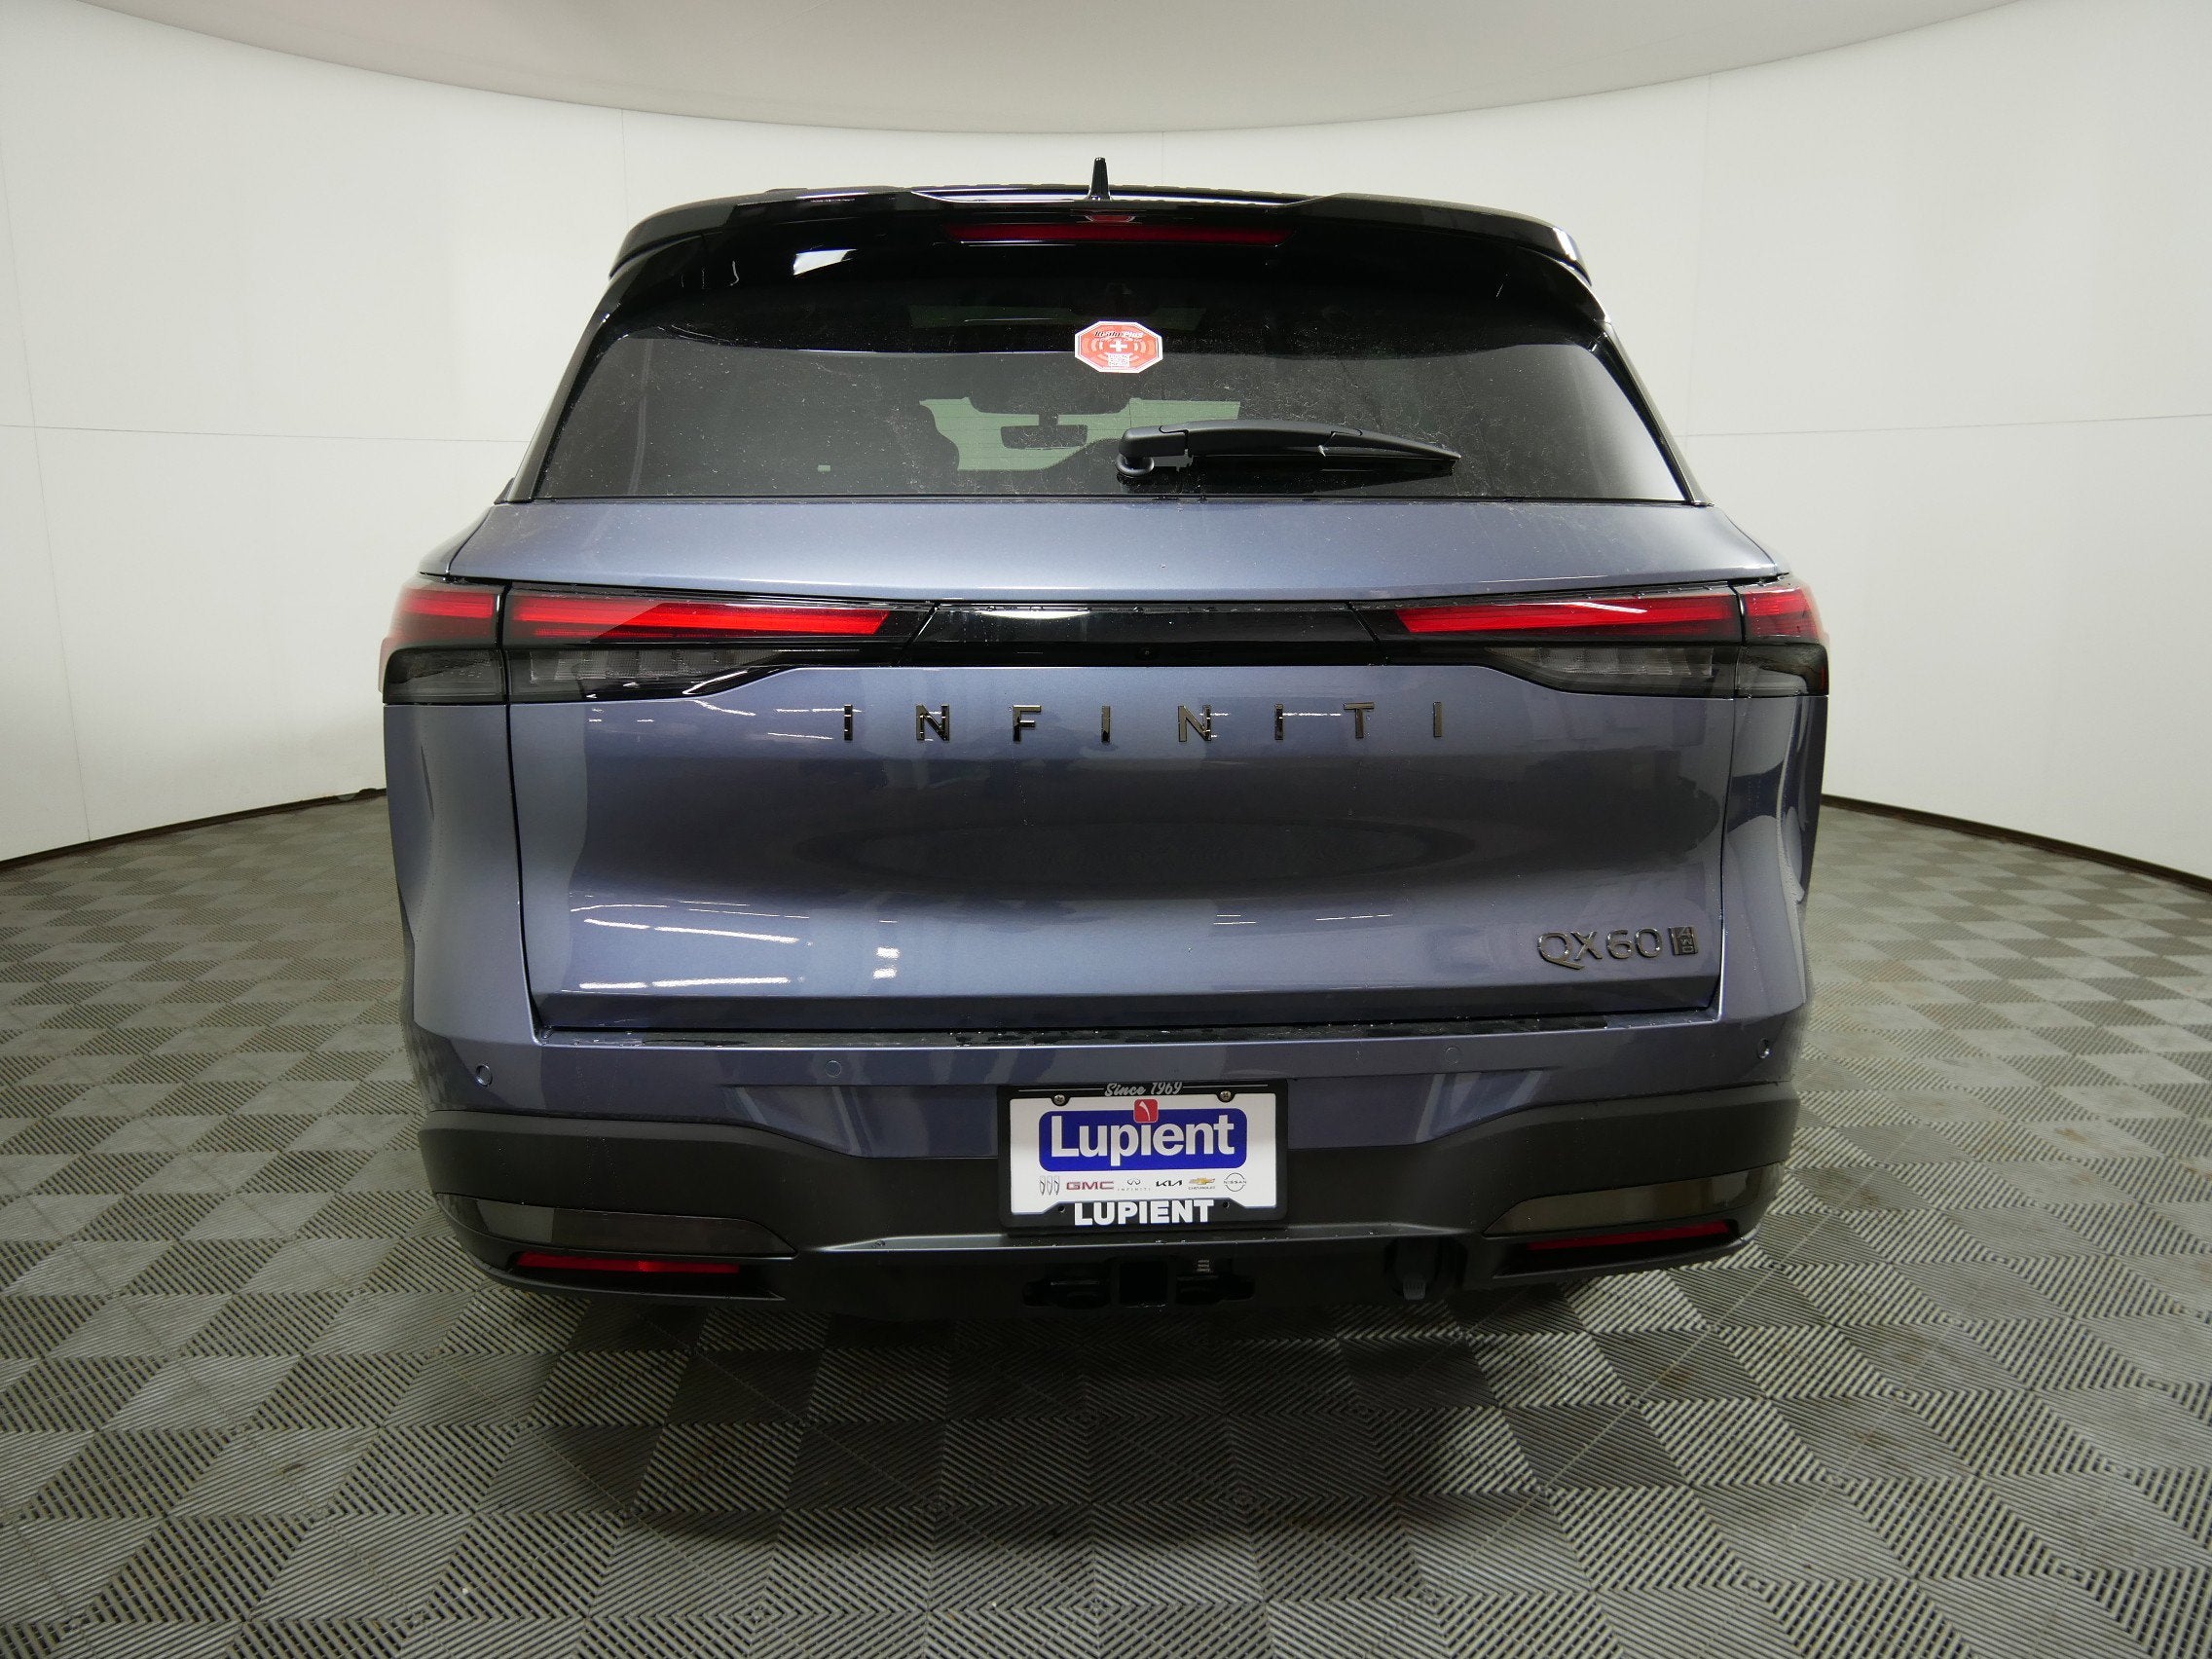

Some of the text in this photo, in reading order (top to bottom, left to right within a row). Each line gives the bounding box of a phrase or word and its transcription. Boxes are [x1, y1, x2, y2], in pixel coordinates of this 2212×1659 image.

[843, 702, 1443, 743] INFINITI
[1537, 928, 1662, 970] QX60
[1104, 1082, 1183, 1097] Since 1969
[1051, 1114, 1235, 1166] Lupient
[1066, 1181, 1115, 1191] GMC
[1074, 1198, 1214, 1226] LUPIENT
